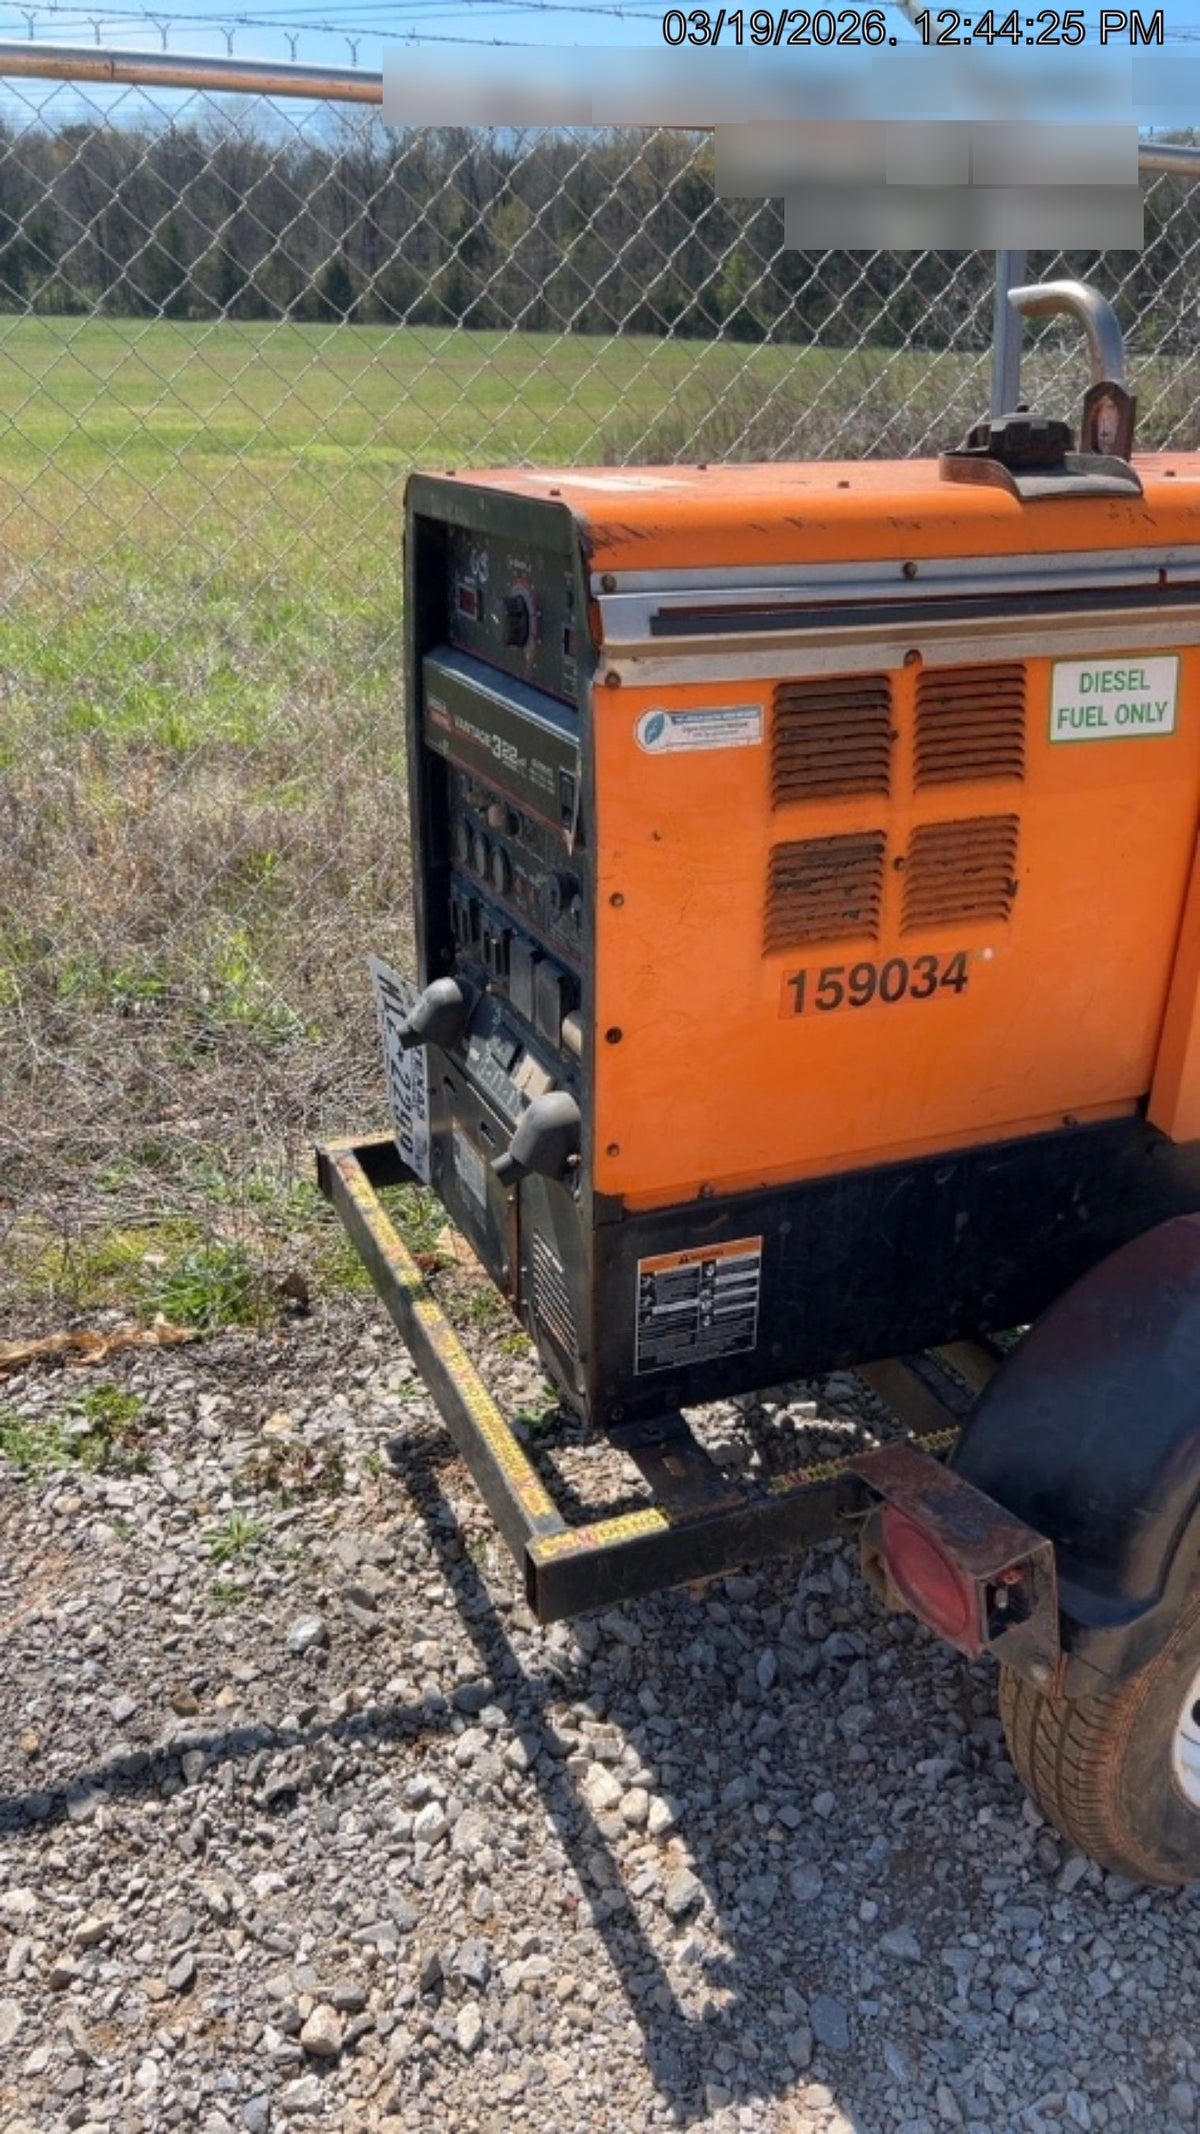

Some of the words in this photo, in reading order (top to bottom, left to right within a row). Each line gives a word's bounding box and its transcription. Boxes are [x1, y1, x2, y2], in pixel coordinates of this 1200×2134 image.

[1079, 668, 1151, 694] DIESEL
[1057, 705, 1108, 729] FUEL
[1115, 700, 1168, 726] ONLY
[787, 951, 969, 1014] 159034
